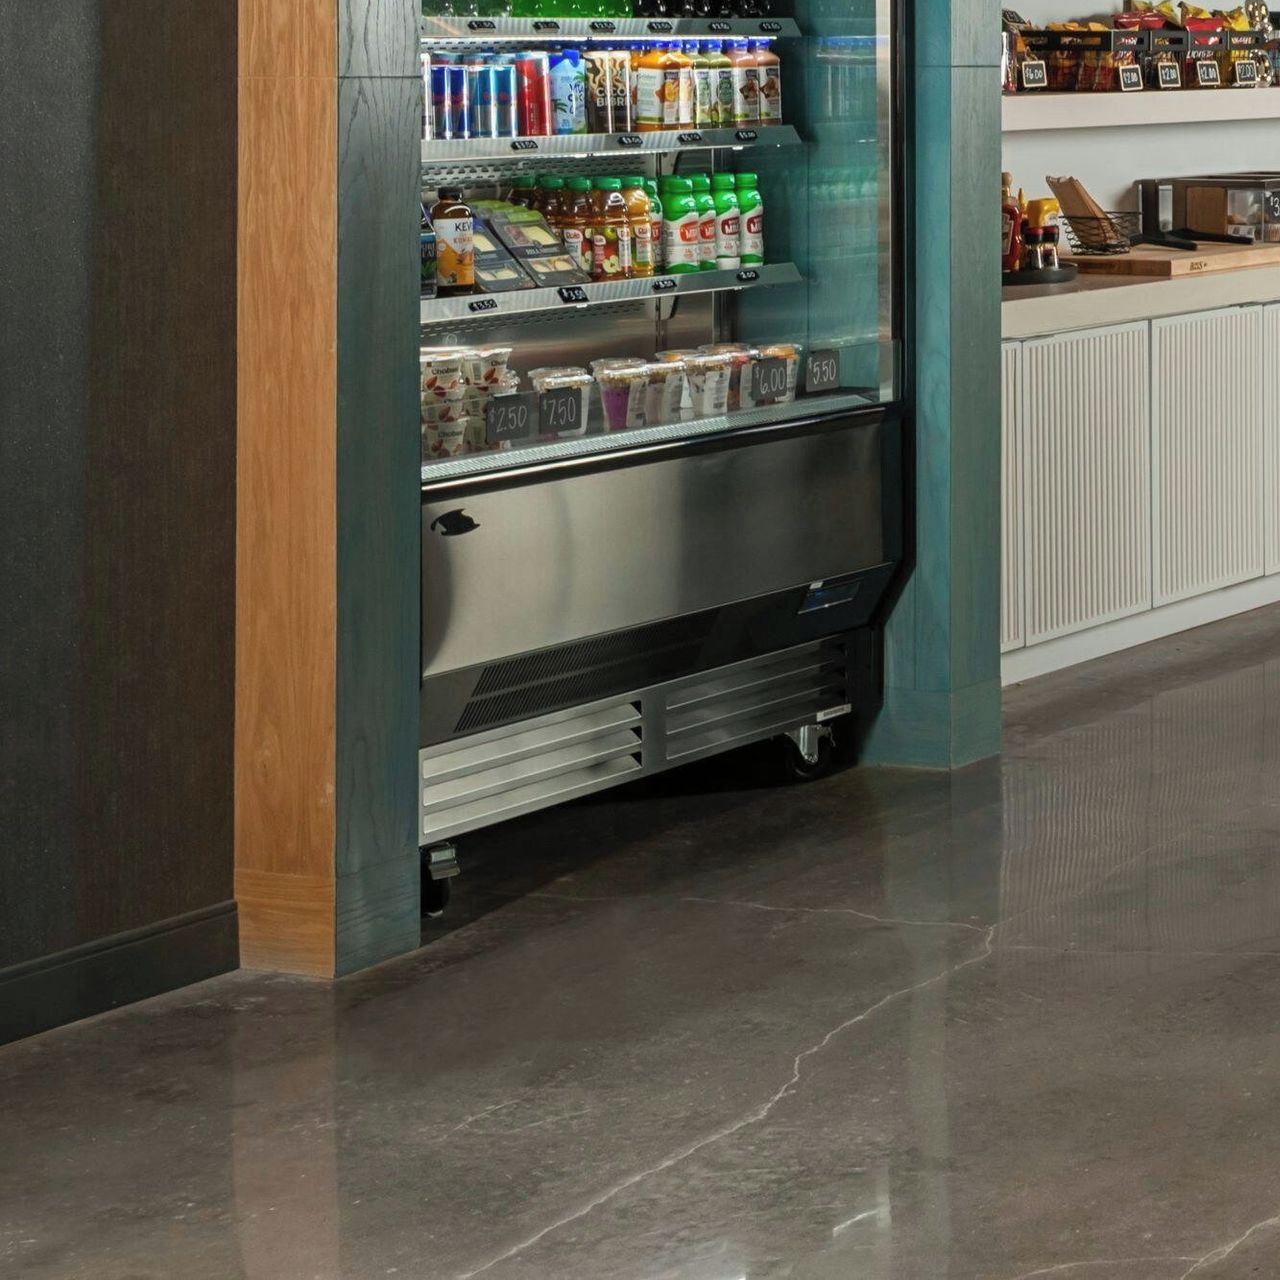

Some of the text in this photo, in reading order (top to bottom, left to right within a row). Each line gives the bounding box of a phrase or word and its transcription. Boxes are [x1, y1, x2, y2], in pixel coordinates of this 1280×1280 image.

[755, 365, 785, 394] $6.00
[808, 357, 837, 385] $5.50
[489, 405, 527, 433] $2.50
[543, 396, 576, 425] $7.50
